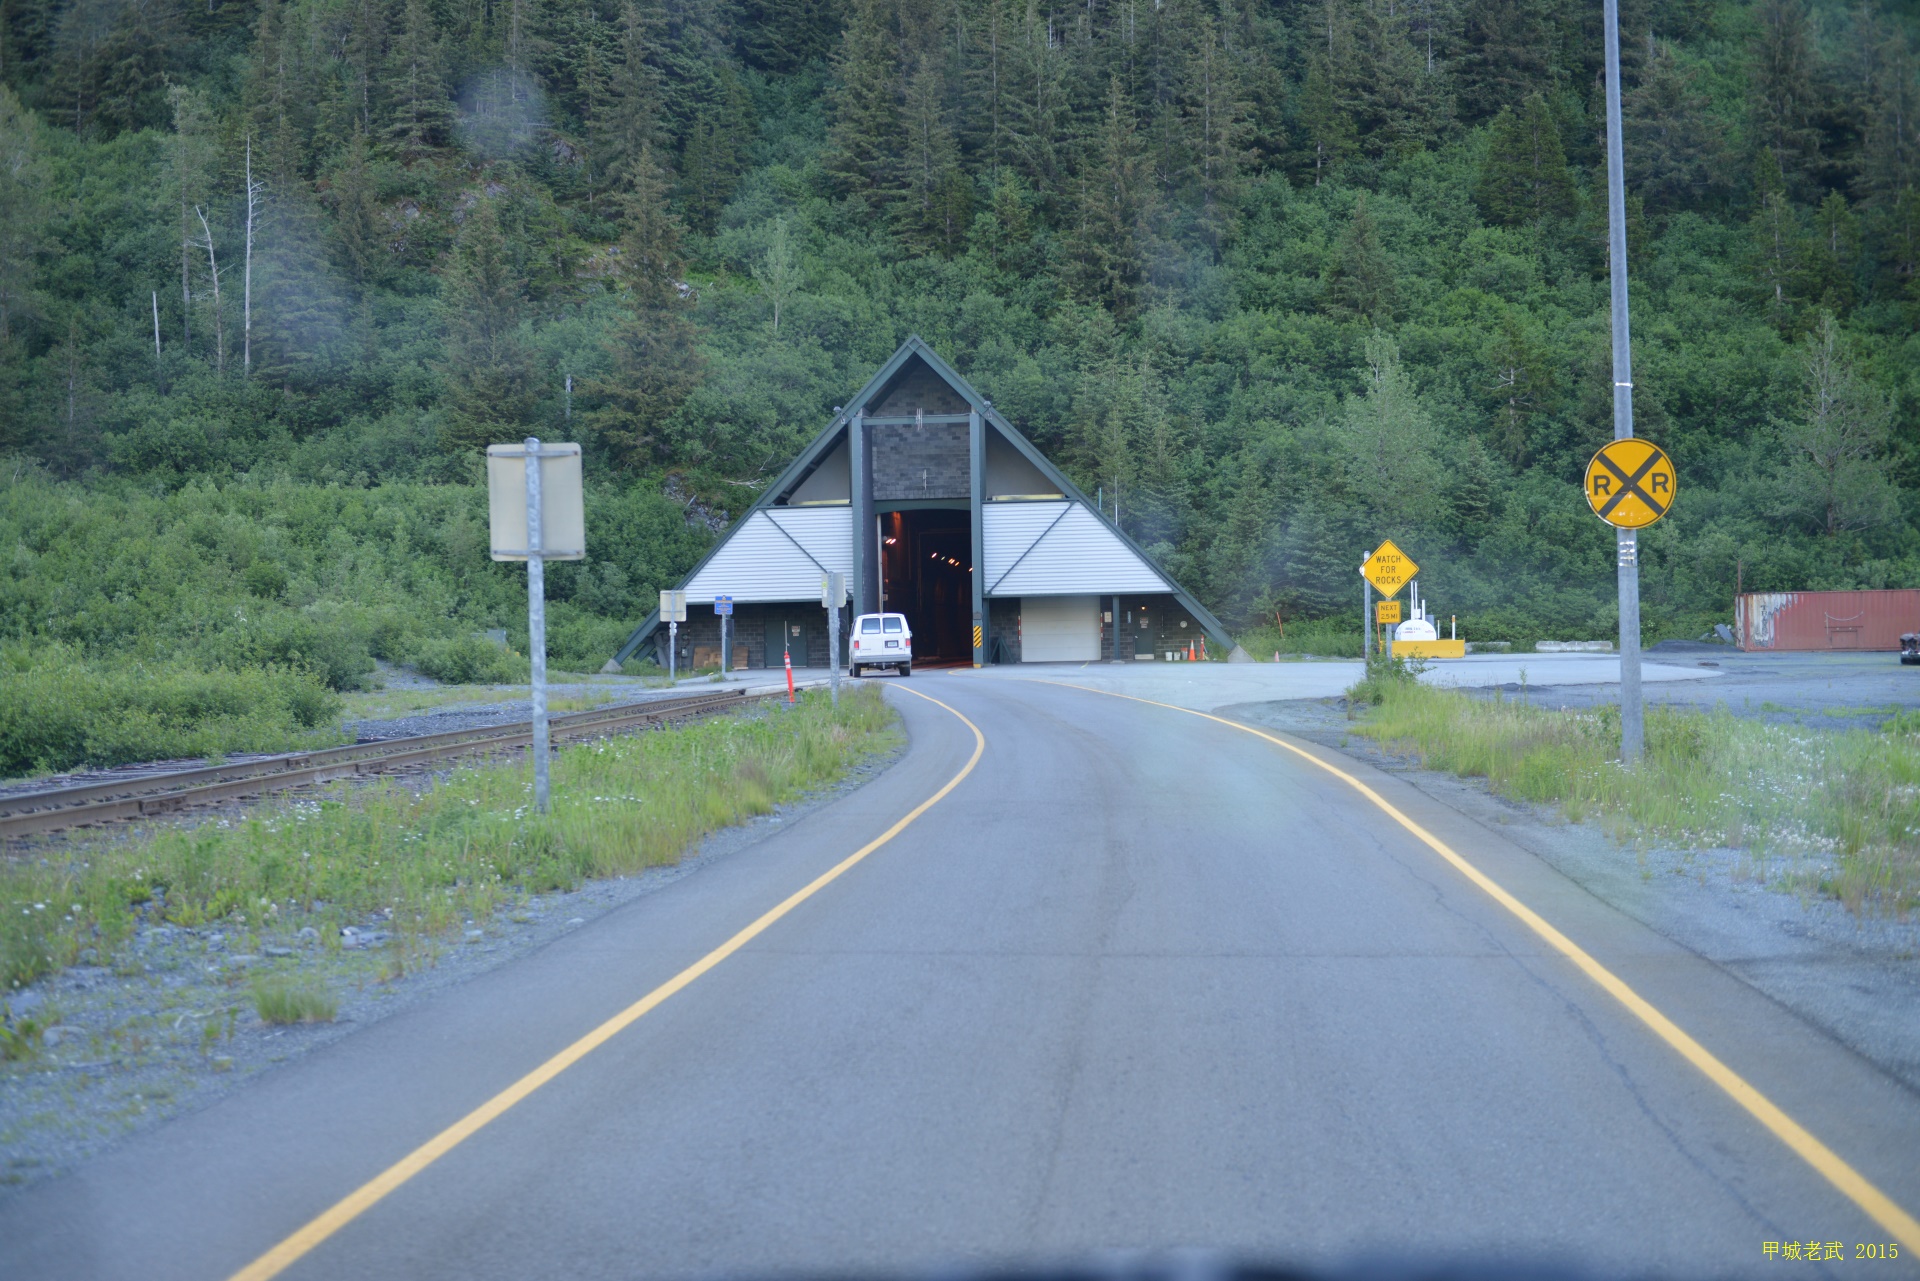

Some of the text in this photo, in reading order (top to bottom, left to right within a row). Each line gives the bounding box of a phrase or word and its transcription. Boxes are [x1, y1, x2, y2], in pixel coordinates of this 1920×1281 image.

[1593, 472, 1669, 496] R R
[1380, 565, 1396, 573] FOR
[1376, 576, 1401, 584] ROCKS
